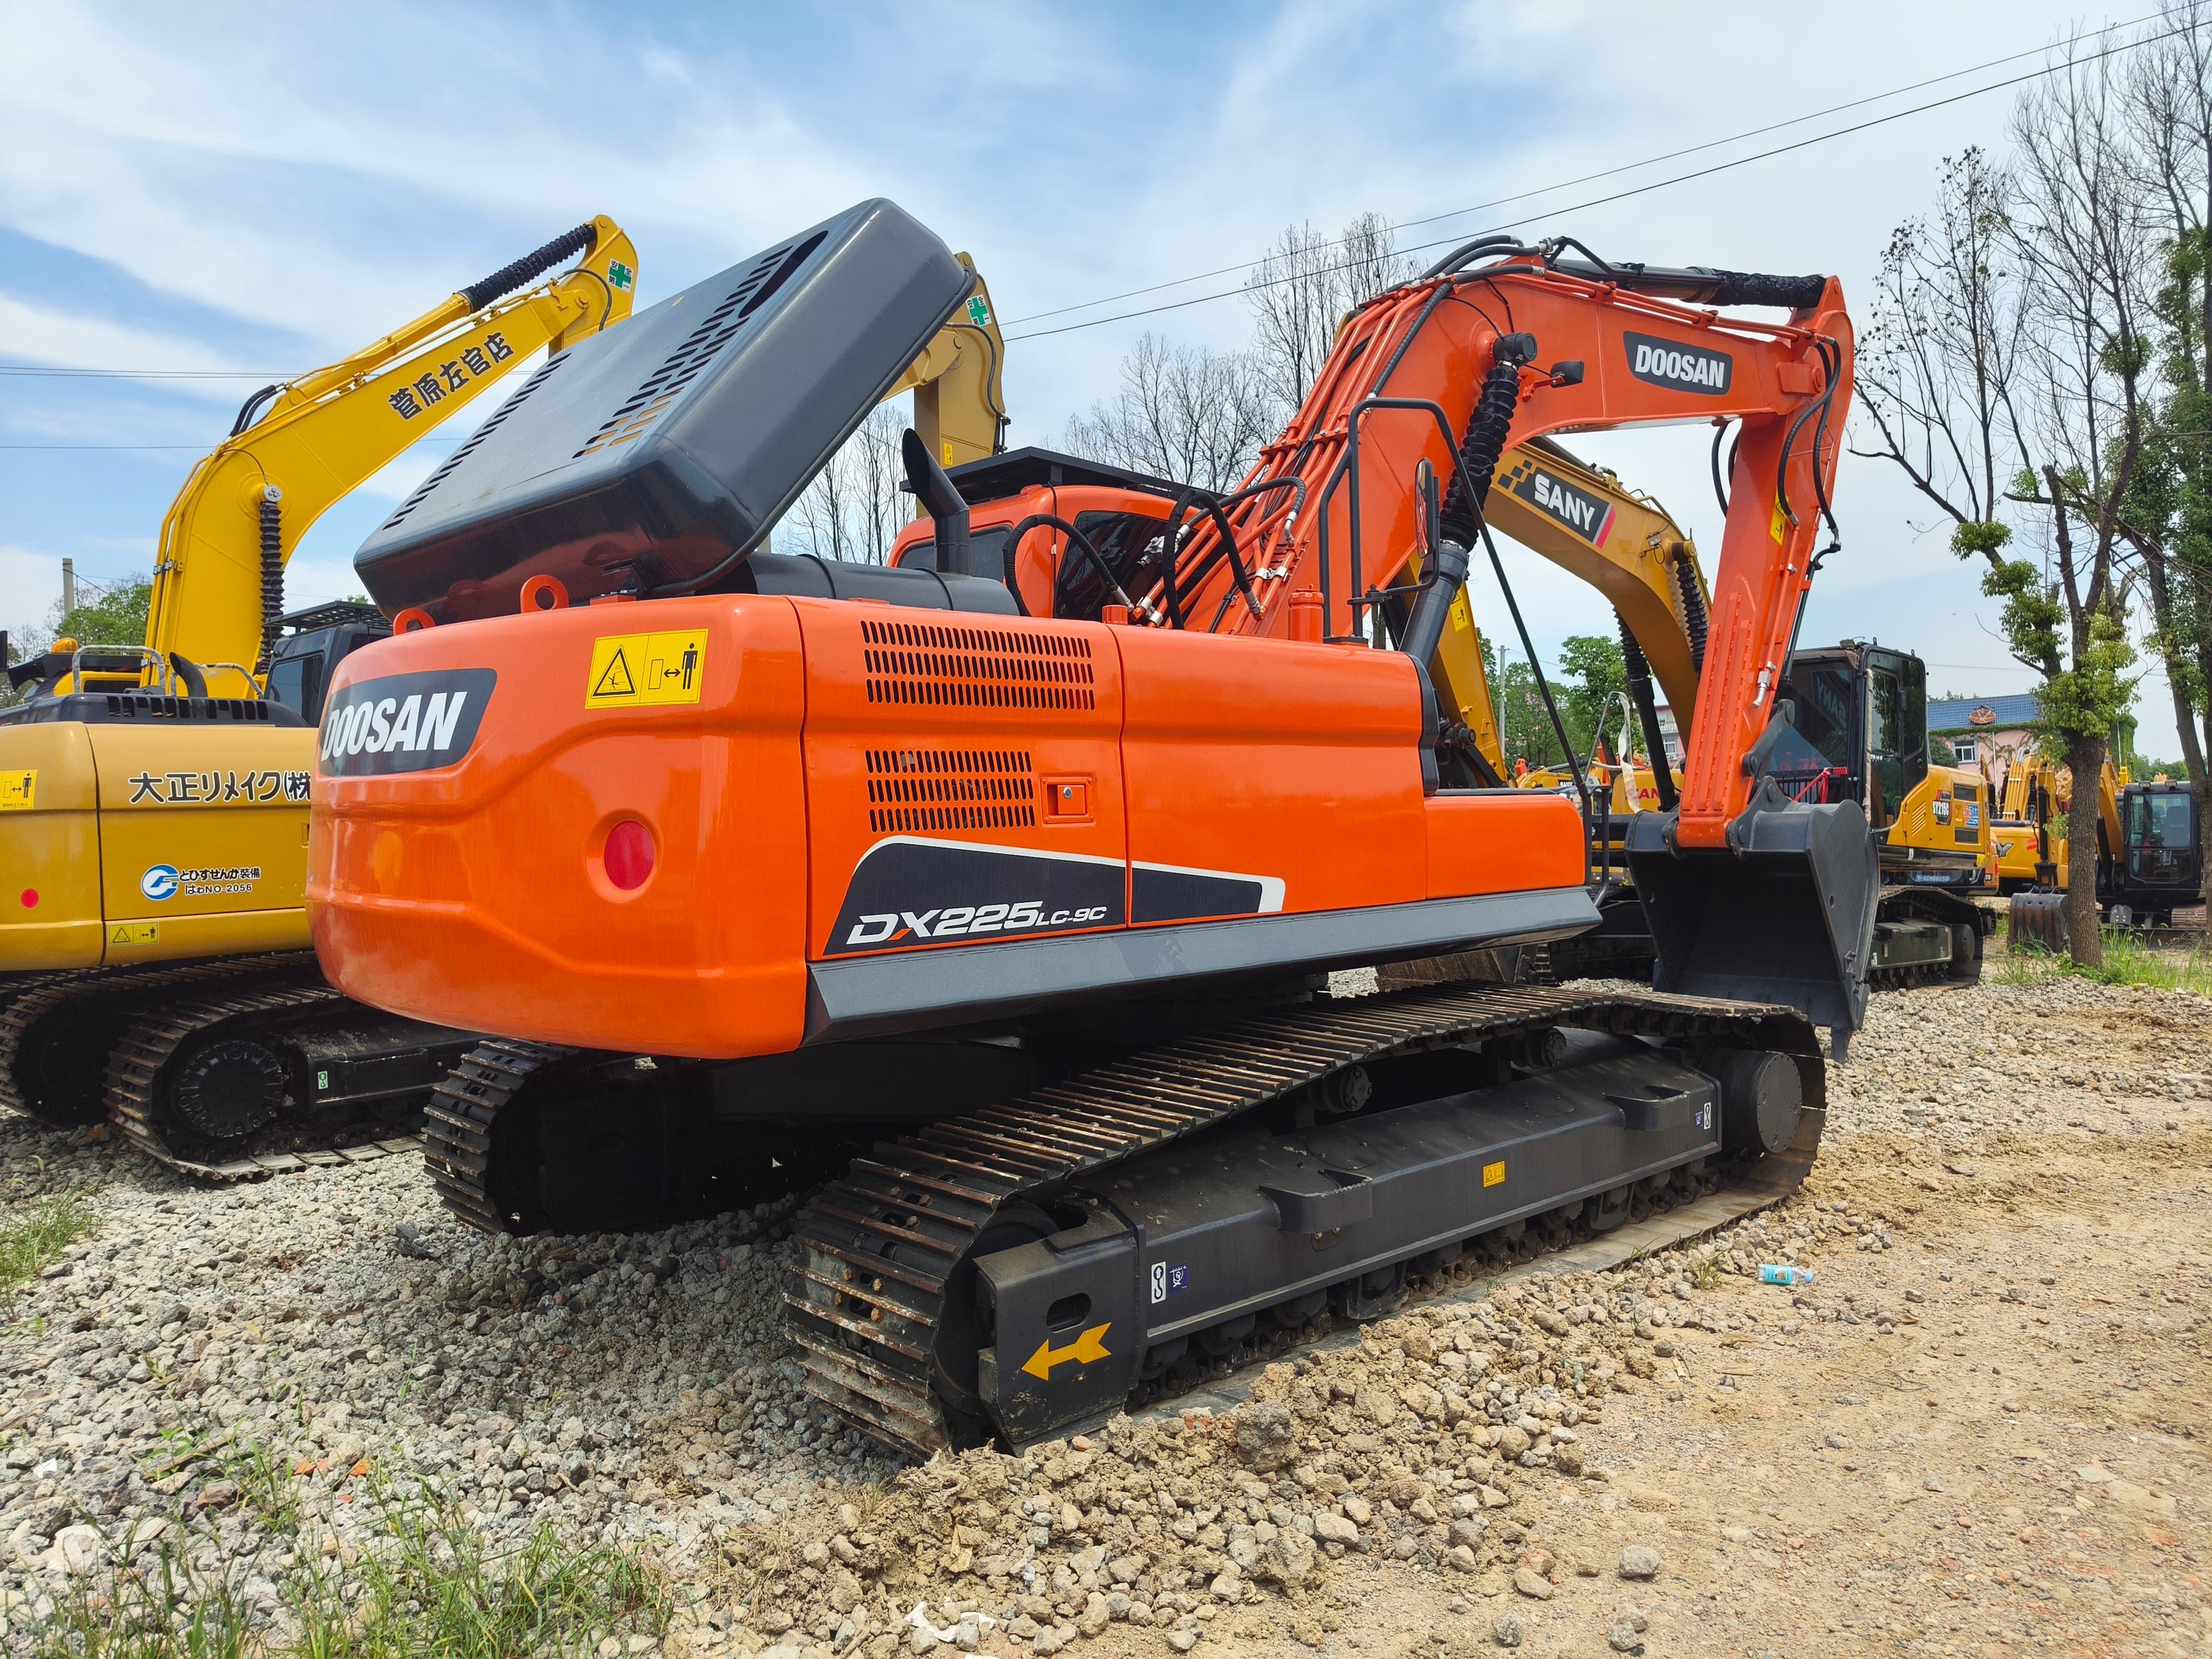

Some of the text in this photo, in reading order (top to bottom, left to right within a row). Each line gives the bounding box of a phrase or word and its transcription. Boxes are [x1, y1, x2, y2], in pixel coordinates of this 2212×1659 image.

[388, 332, 514, 420] 菅原左官店
[1635, 345, 1725, 388] DOOSAN
[1534, 474, 1595, 531] SANY
[321, 691, 468, 761] DOOSAN
[846, 901, 1107, 945] DX225LC-9C
